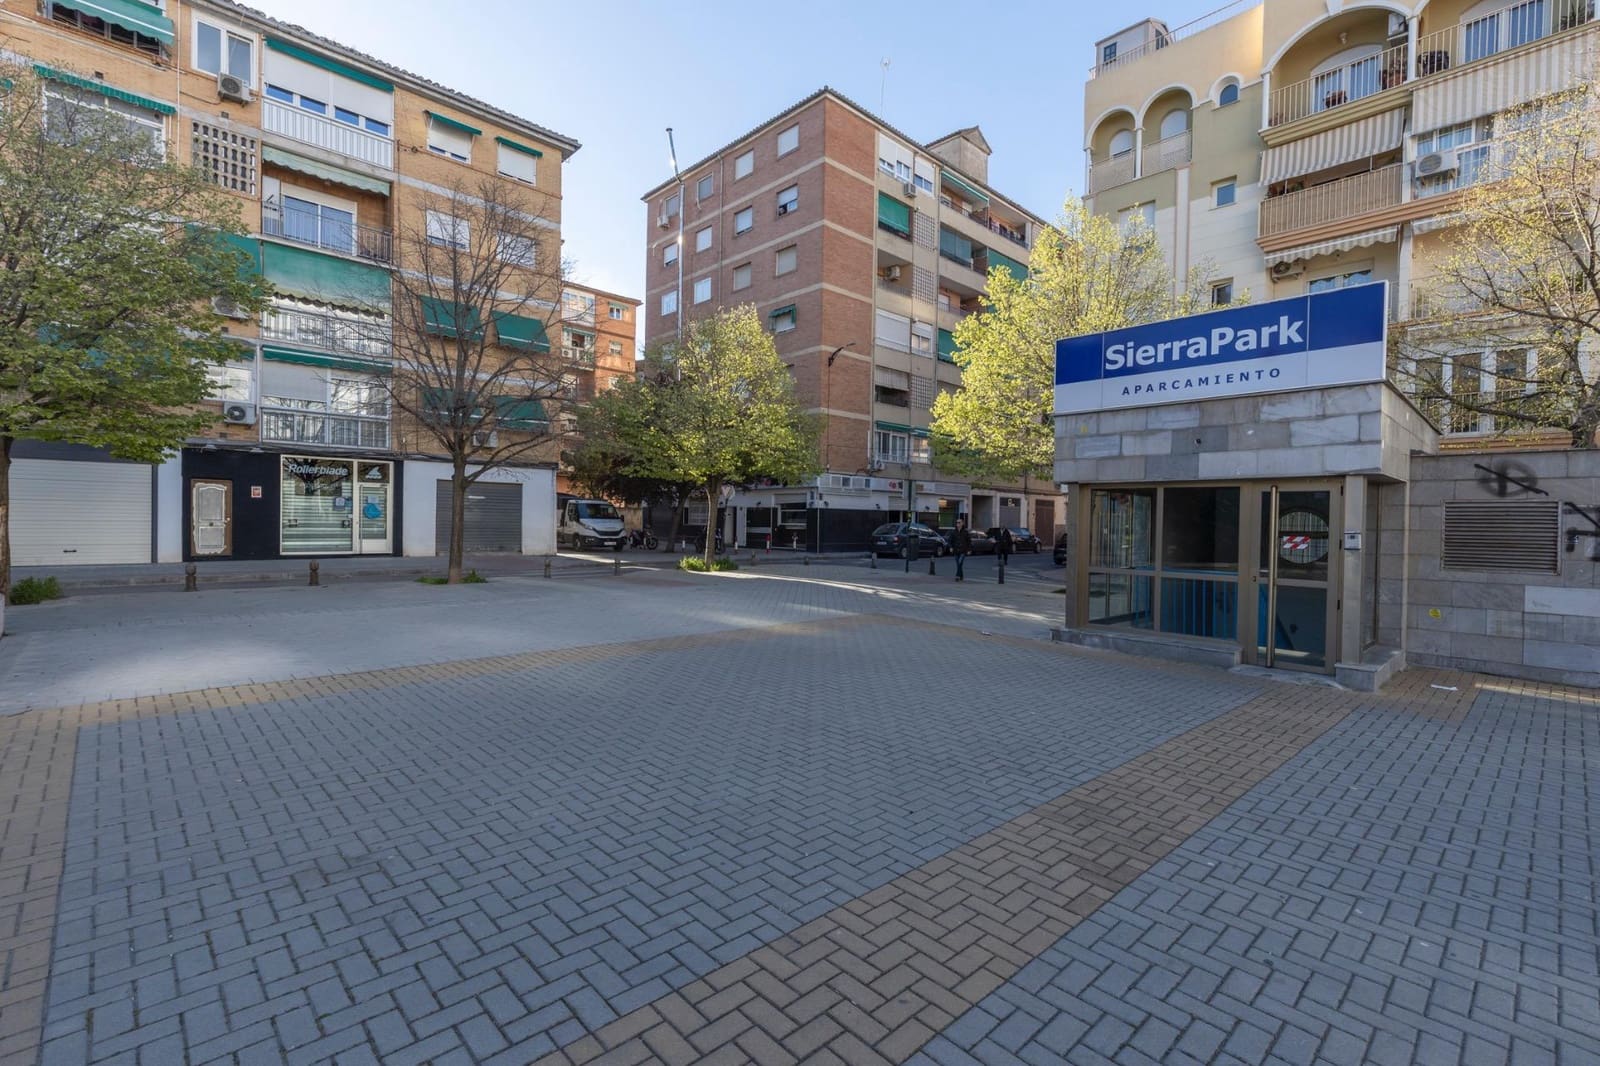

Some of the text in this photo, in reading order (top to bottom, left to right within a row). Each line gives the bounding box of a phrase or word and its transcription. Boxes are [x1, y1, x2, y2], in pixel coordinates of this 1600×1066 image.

[1105, 315, 1305, 370] SierraPark
[1121, 368, 1281, 396] APARCAMIENTO
[288, 463, 349, 476] Rollerblade
